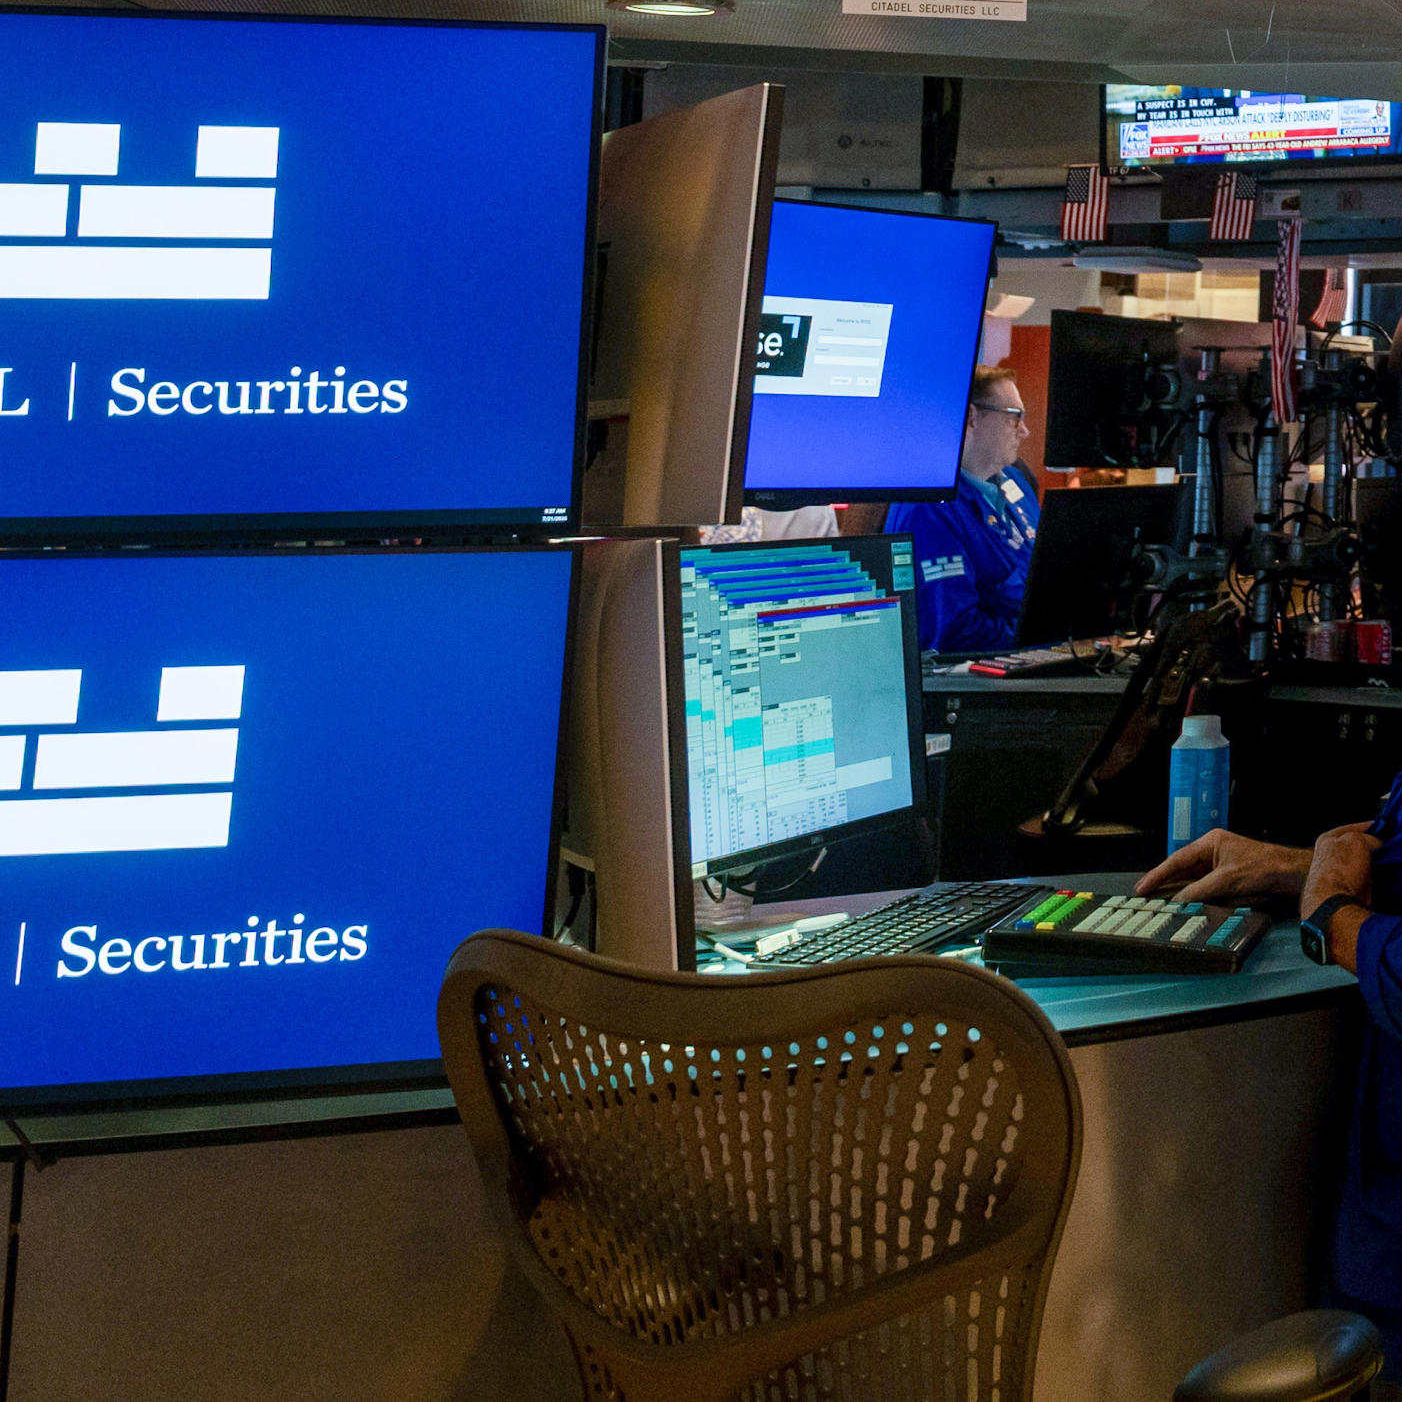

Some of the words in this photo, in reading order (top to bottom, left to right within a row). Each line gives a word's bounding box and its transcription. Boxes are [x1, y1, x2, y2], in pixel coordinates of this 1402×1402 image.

[872, 2, 912, 12] CITADEL
[919, 4, 975, 14] SECURITIES
[982, 7, 999, 16] LLC
[108, 366, 407, 416] Securities
[57, 913, 367, 978] Securities
